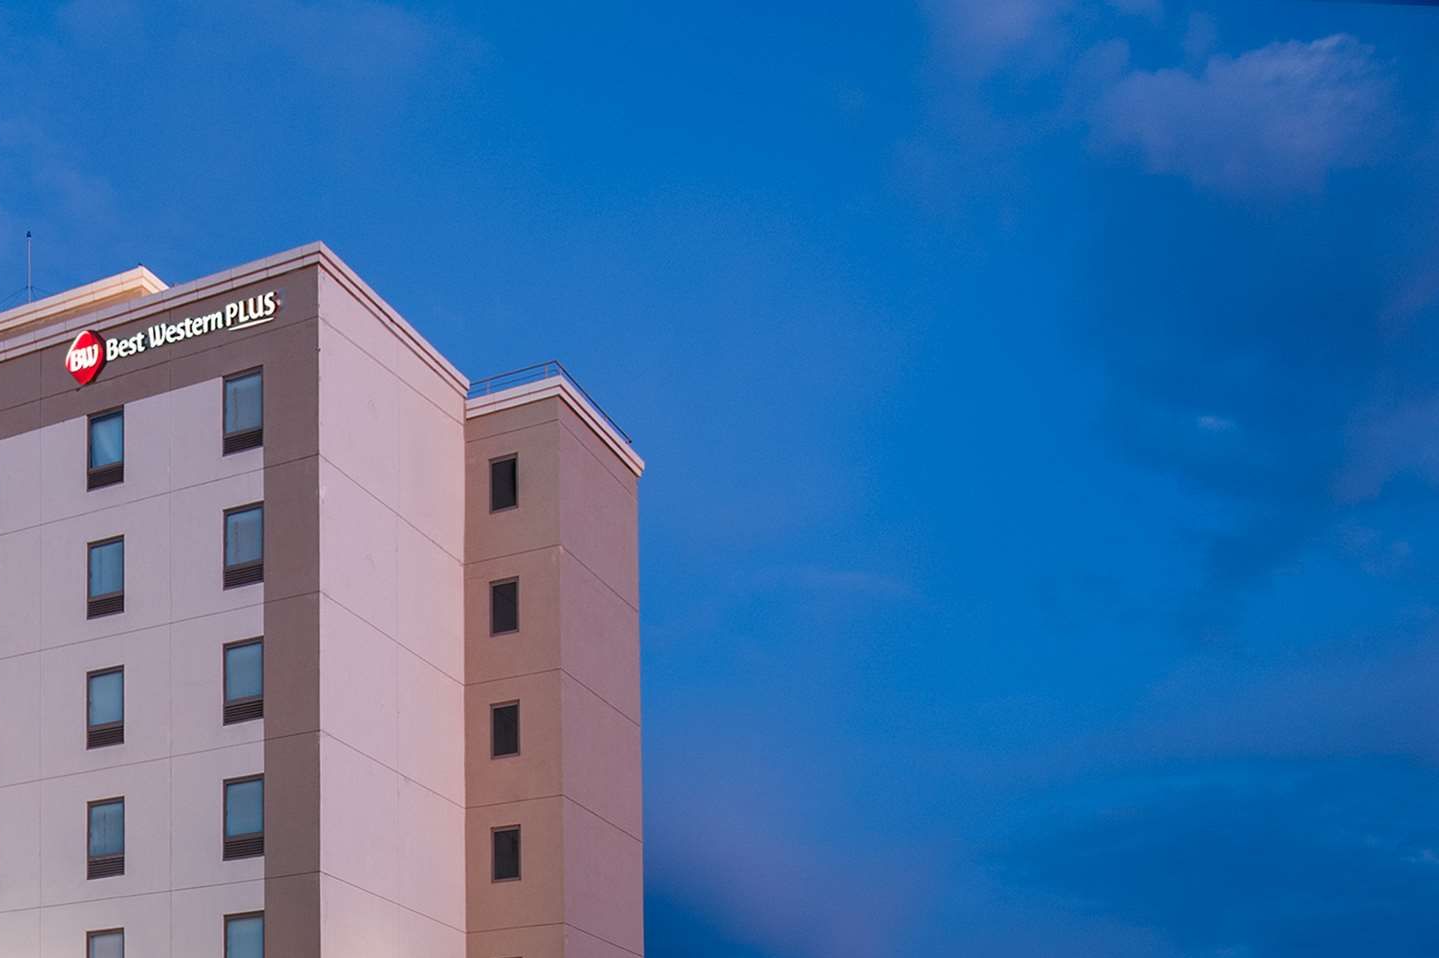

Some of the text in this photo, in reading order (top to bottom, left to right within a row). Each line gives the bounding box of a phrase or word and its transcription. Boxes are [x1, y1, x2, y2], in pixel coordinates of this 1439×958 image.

[105, 291, 277, 362] Best Western PLUS
[69, 343, 99, 373] BW
